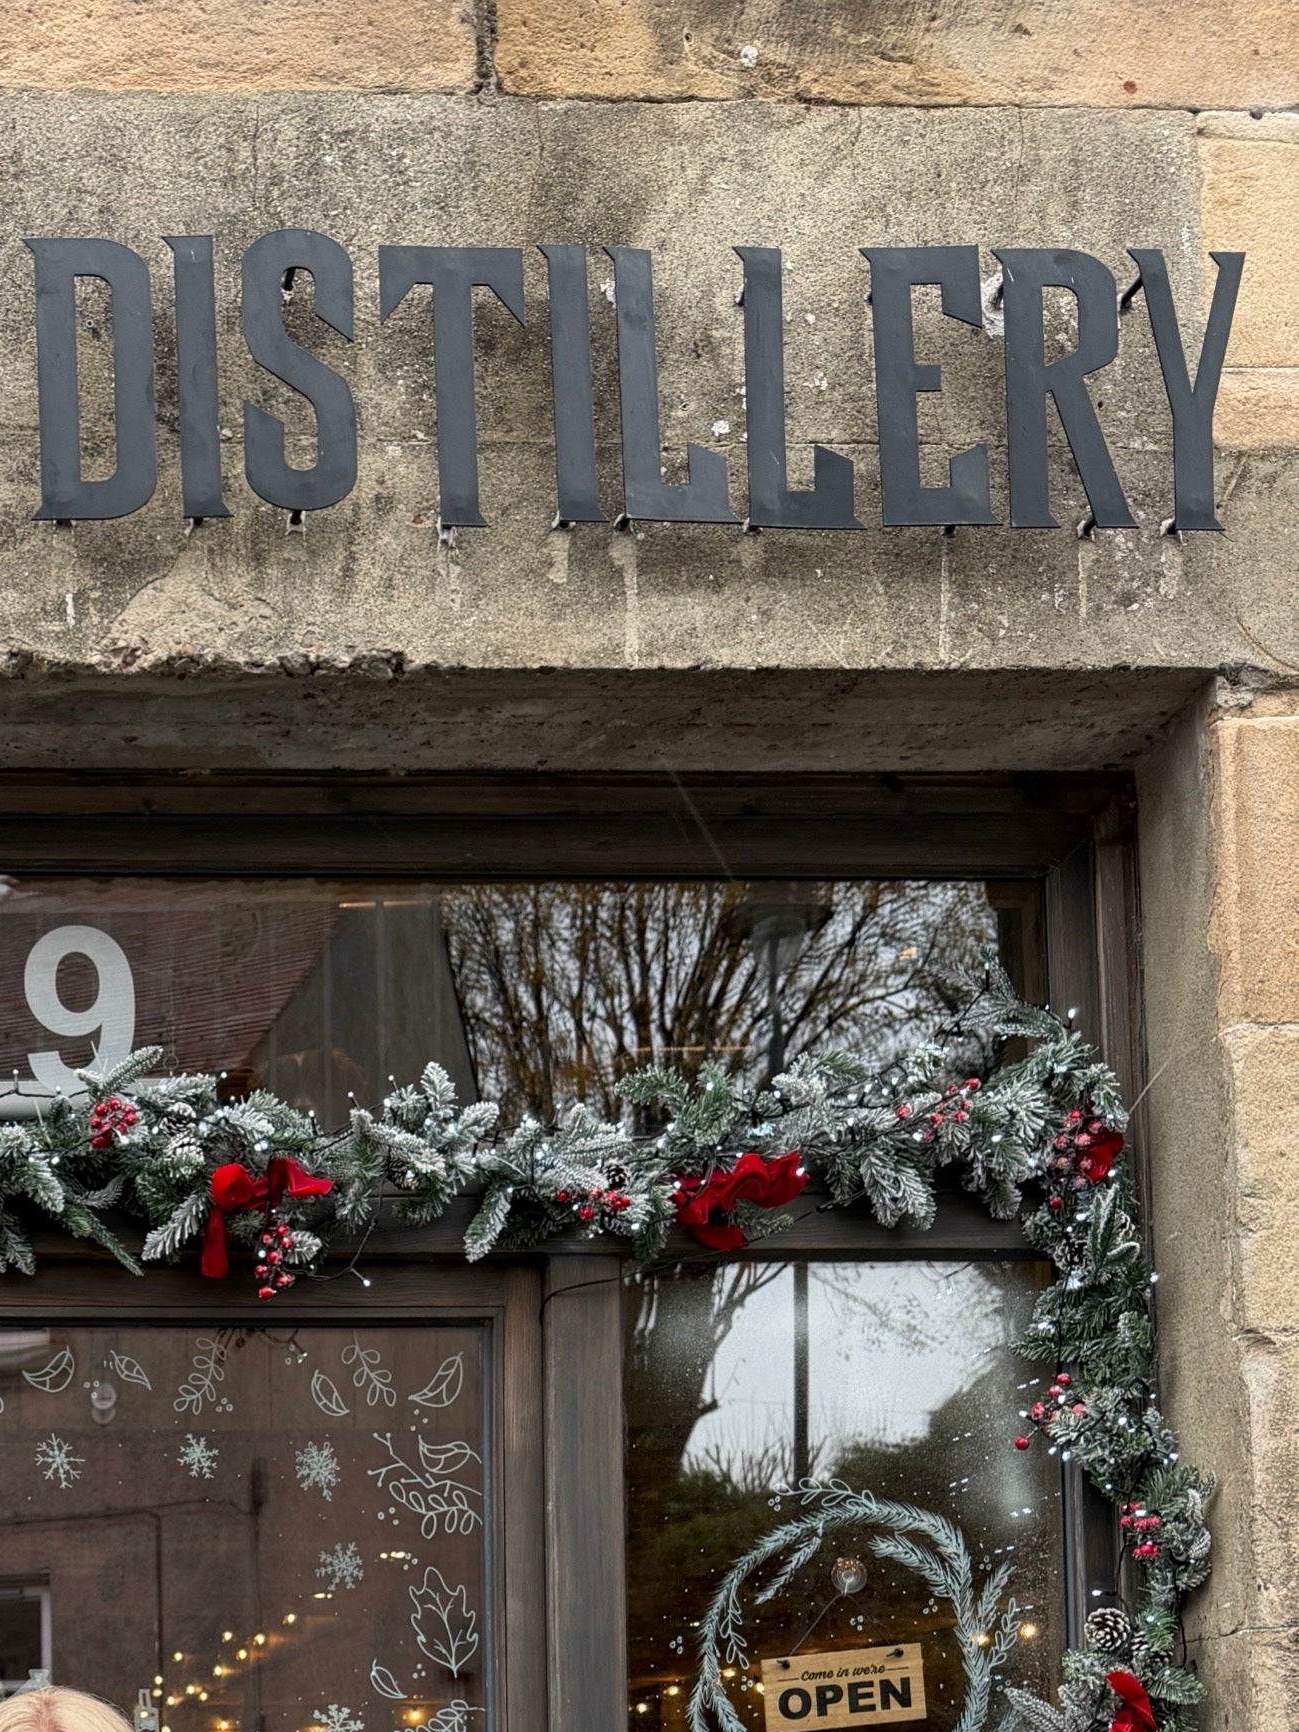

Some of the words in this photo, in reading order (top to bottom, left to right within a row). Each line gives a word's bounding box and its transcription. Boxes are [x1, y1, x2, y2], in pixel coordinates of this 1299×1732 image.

[23, 228, 1246, 532] DISTILLERY
[24, 925, 135, 1099] 9
[778, 1677, 912, 1720] OPEN
[801, 1670, 834, 1682] Come
[837, 1667, 850, 1678] in
[852, 1664, 886, 1675] we're
